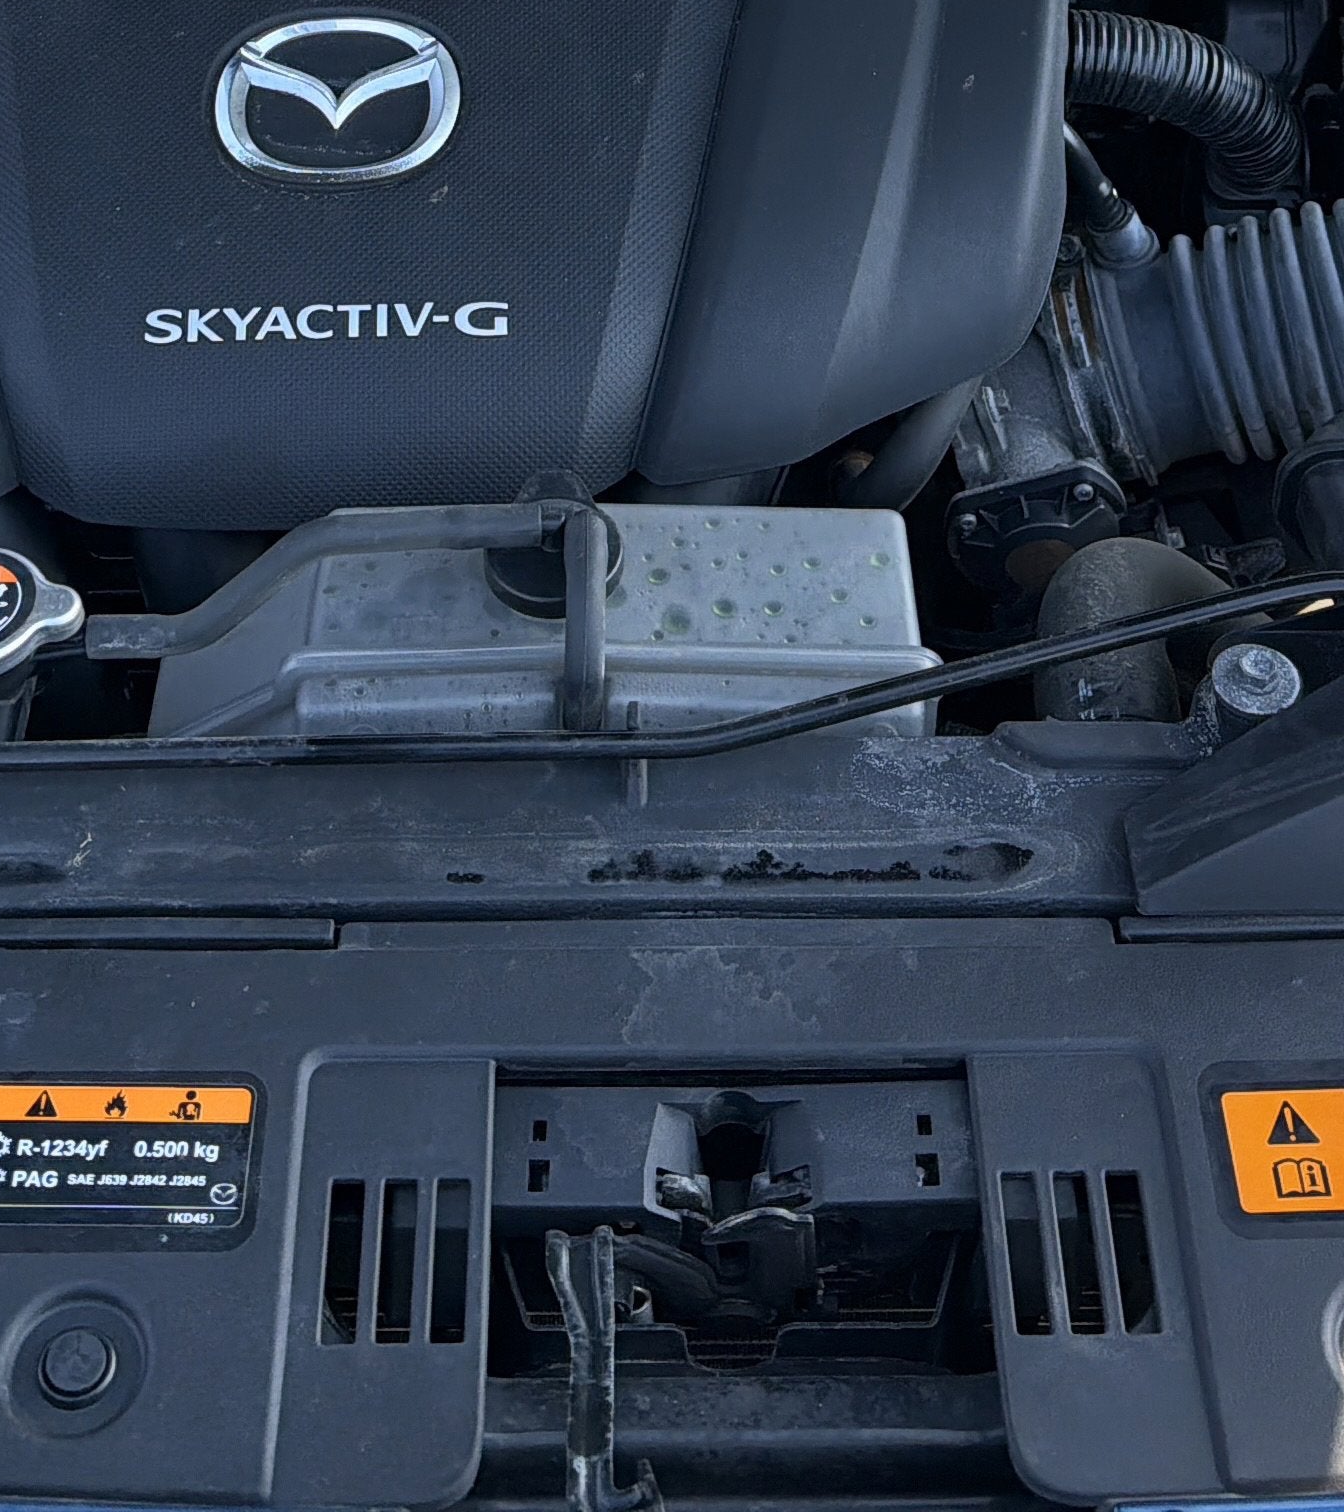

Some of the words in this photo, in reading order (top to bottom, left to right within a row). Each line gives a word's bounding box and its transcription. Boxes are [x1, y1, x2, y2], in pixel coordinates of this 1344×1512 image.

[143, 301, 509, 345] SKYACTIV-G
[16, 1139, 110, 1161] R-1234yf
[133, 1141, 188, 1158] 0.500
[194, 1141, 220, 1163] kg
[11, 1170, 58, 1188] PAG
[67, 1174, 95, 1186] SAE
[96, 1174, 127, 1186] J639
[128, 1174, 167, 1186] J2842
[168, 1174, 207, 1187] J2845
[167, 1211, 215, 1225] (KD45)
